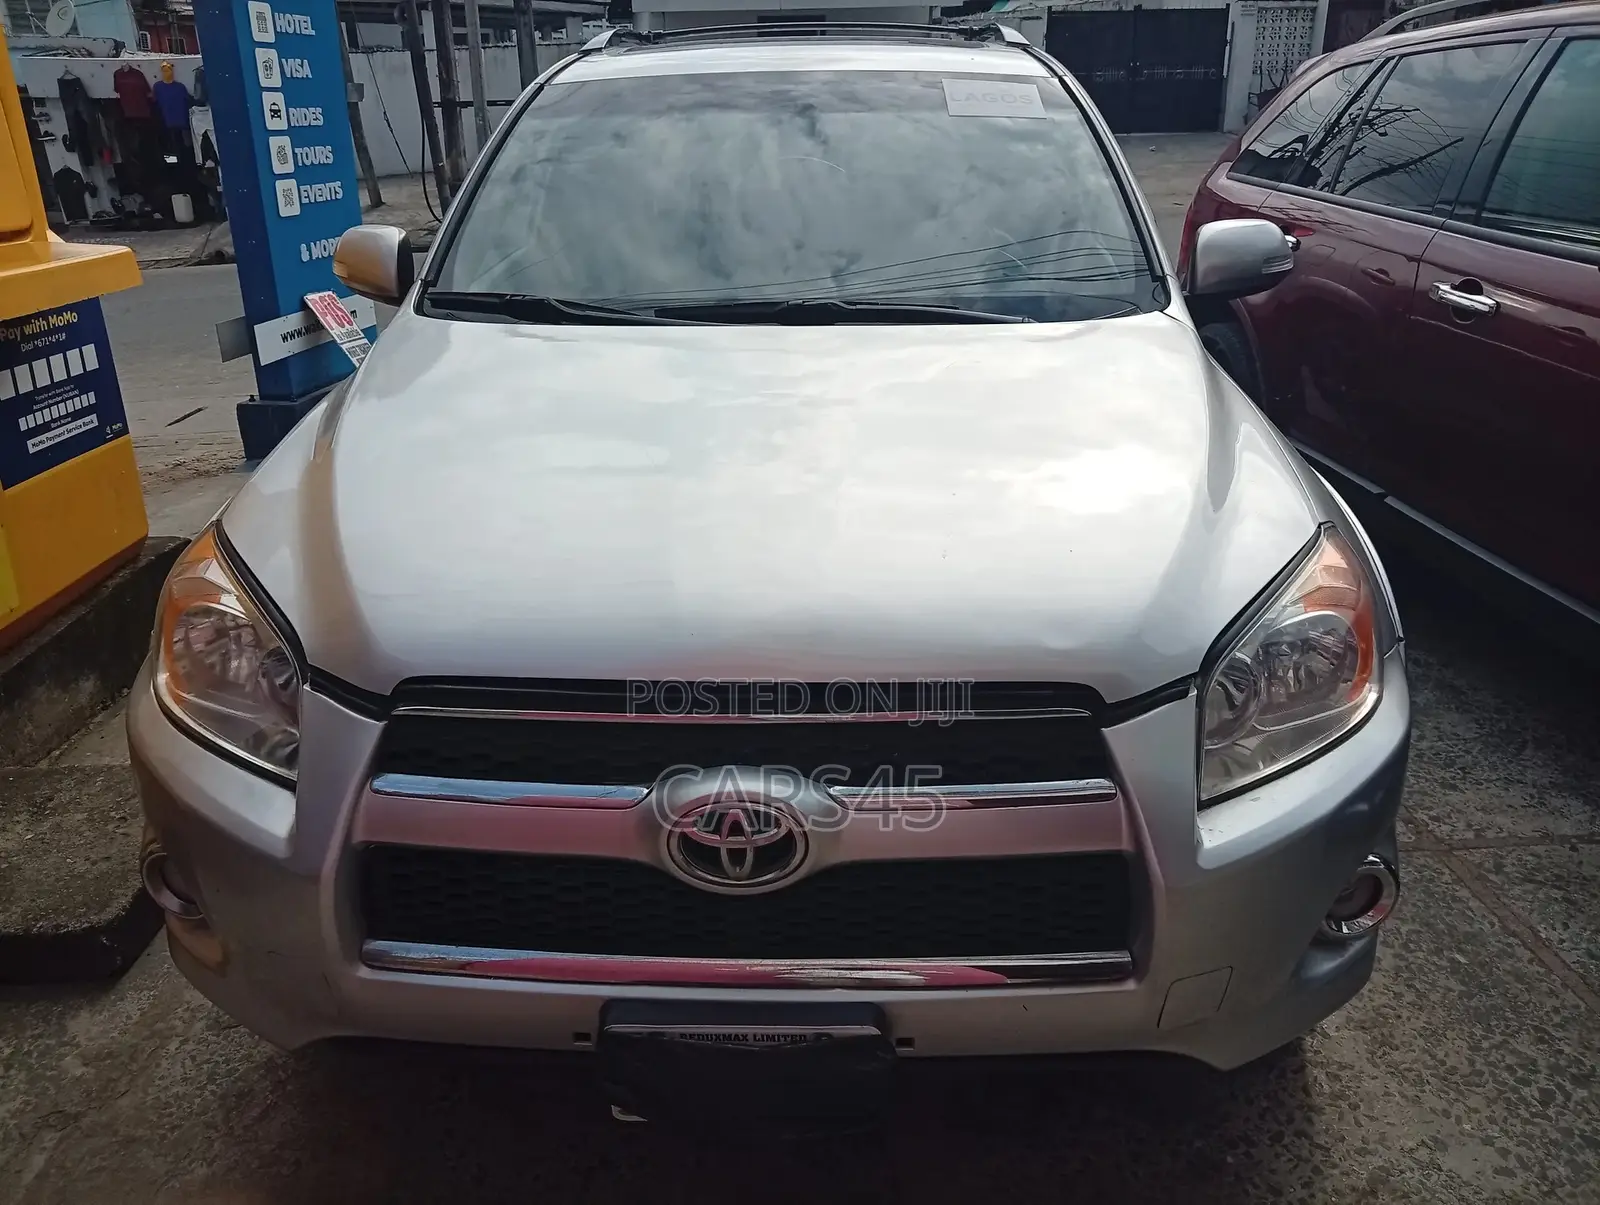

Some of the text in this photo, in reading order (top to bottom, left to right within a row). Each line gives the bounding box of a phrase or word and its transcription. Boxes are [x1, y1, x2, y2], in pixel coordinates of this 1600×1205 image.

[274, 12, 316, 36] HOTEL
[281, 58, 313, 79] VISA
[950, 92, 1033, 105] LAGOS
[288, 107, 324, 127] RIDES
[294, 145, 334, 167] TOURS
[299, 181, 343, 204] EVENTS
[300, 236, 341, 262] & MOR
[309, 293, 354, 331] POS
[0, 311, 78, 341] Pay with MoMo
[21, 342, 34, 352] Dial
[31, 418, 94, 449] MoMo Payment Service Bank
[753, 1033, 808, 1043] LIMITED
